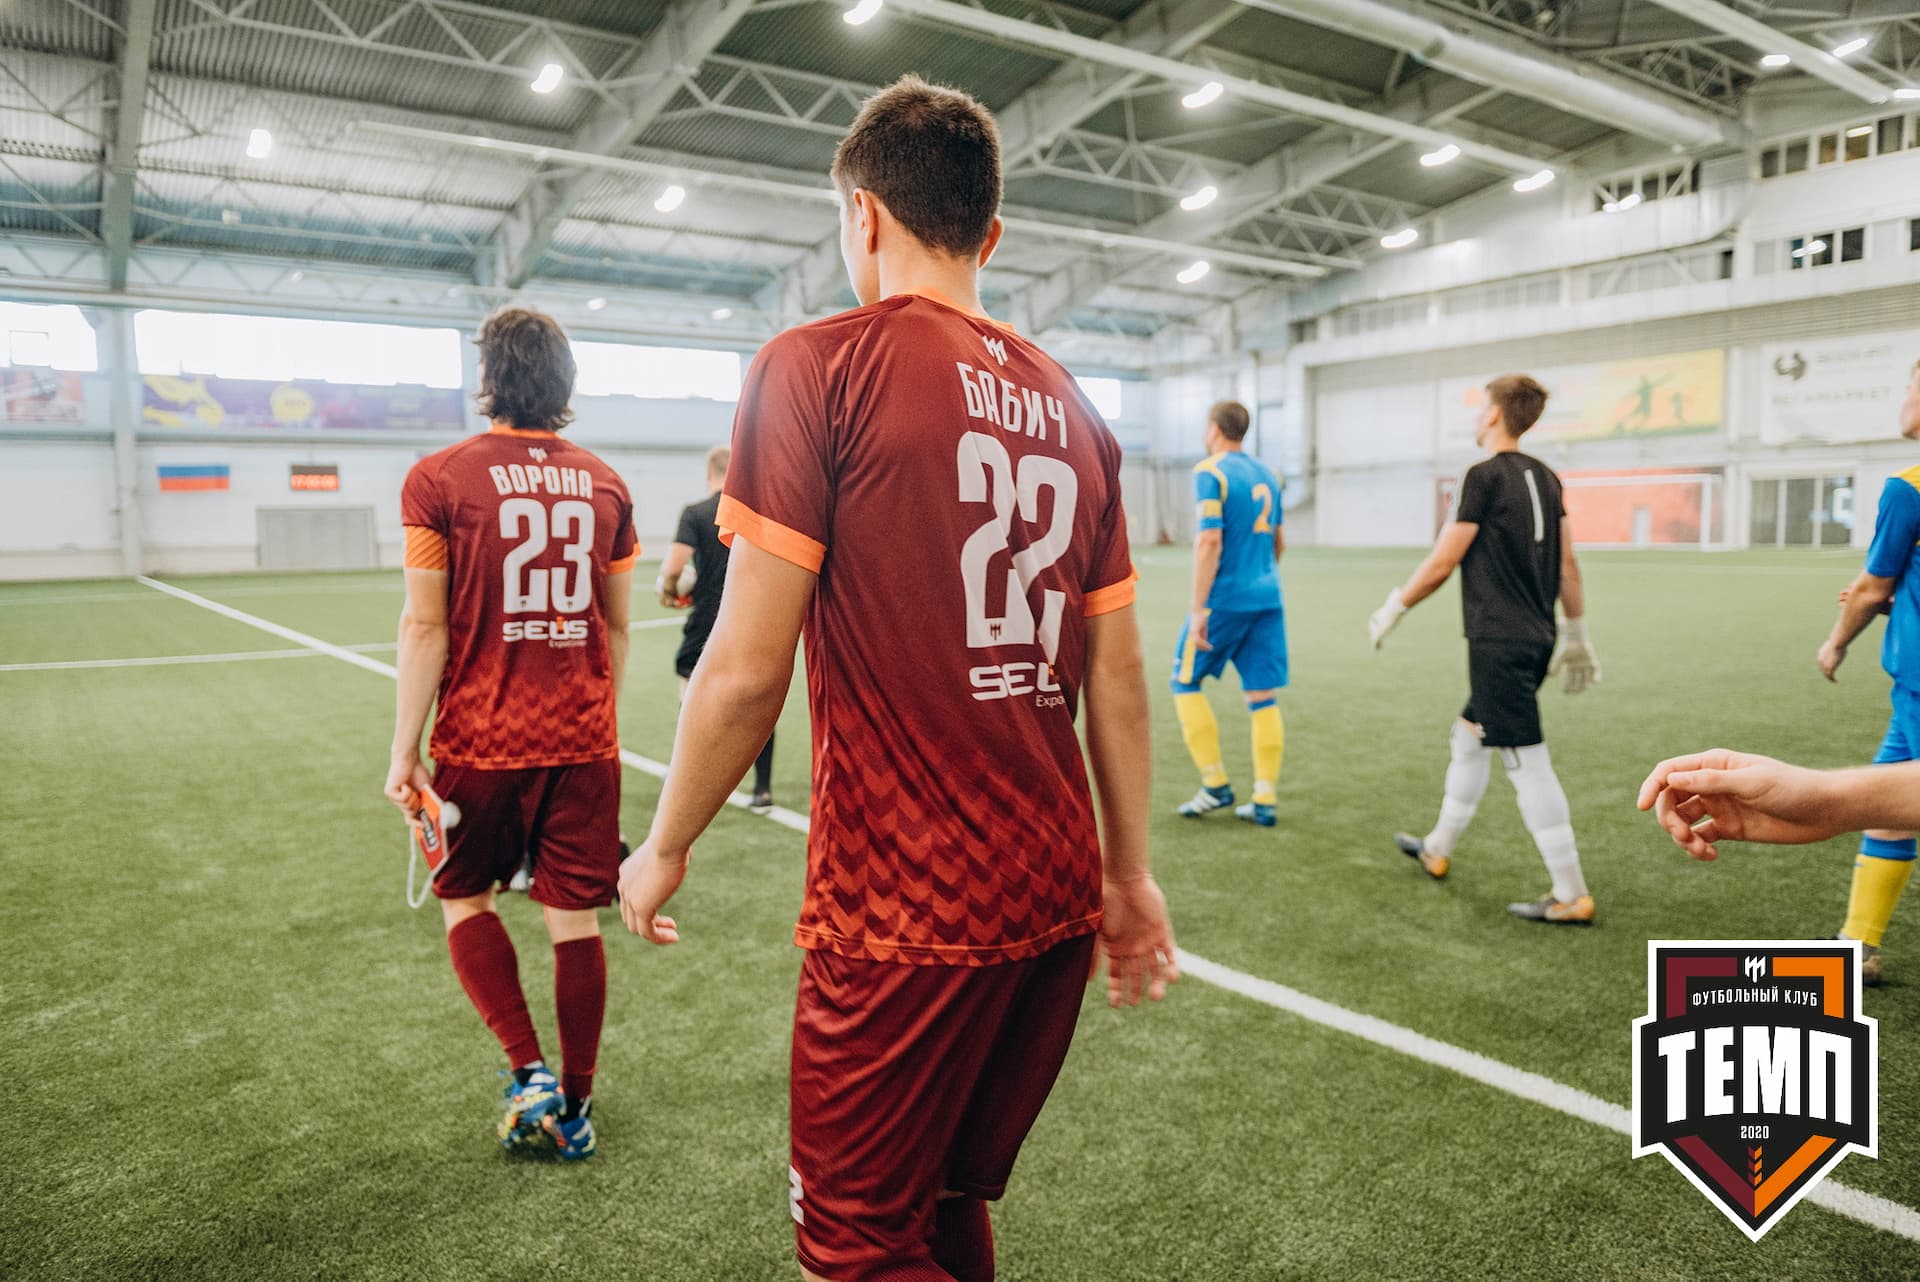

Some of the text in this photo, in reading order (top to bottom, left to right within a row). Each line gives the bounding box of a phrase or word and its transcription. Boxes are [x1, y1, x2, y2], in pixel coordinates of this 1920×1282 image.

[956, 361, 1068, 448] БАБИЧ
[488, 464, 593, 499] ВОРОНА
[1252, 483, 1272, 534] 2
[1524, 468, 1544, 542] 1
[499, 498, 595, 614] 23
[956, 430, 1078, 666] 22
[502, 616, 588, 642] SEUS
